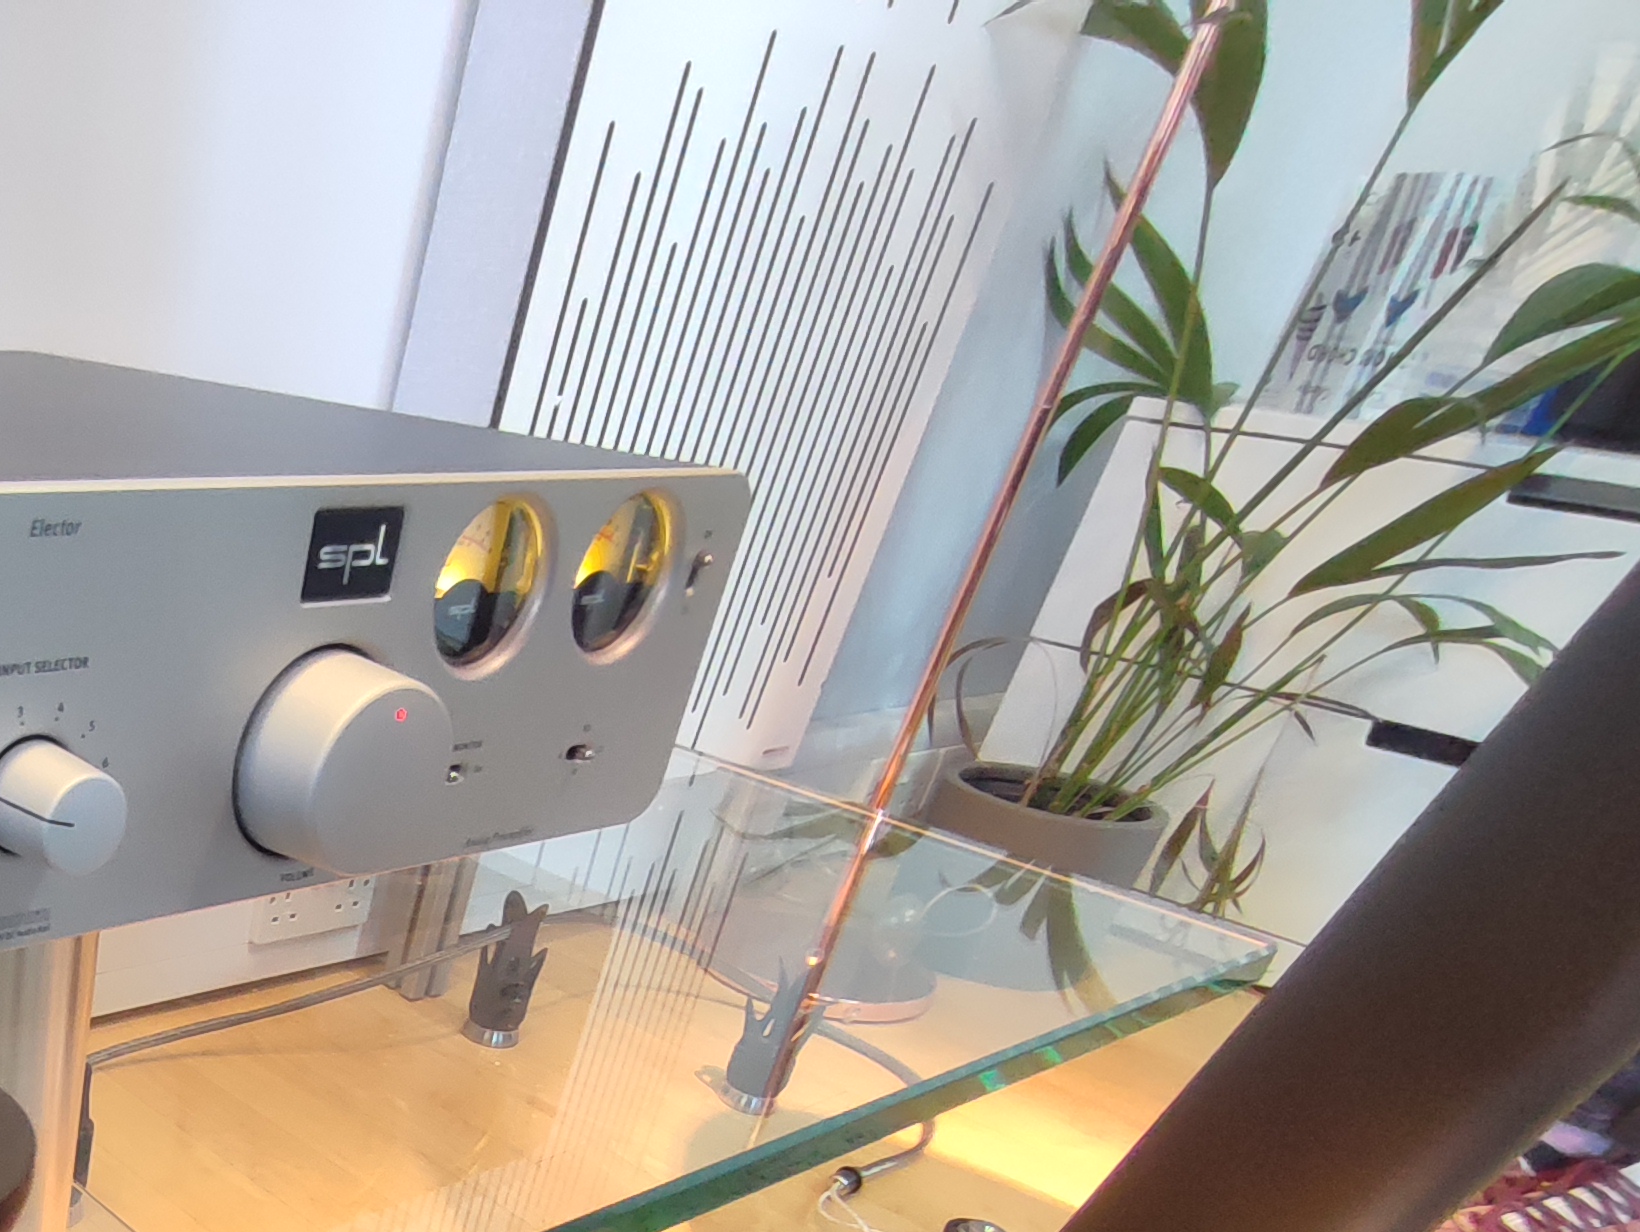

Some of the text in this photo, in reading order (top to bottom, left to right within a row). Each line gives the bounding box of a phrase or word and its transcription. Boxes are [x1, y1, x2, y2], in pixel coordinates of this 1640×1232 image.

[30, 519, 82, 537] Elector
[317, 523, 389, 586] spl
[34, 656, 90, 674] SELECTOR
[17, 706, 24, 718] 3
[57, 702, 65, 713] 4
[88, 720, 96, 732] 5
[101, 757, 110, 769] 6
